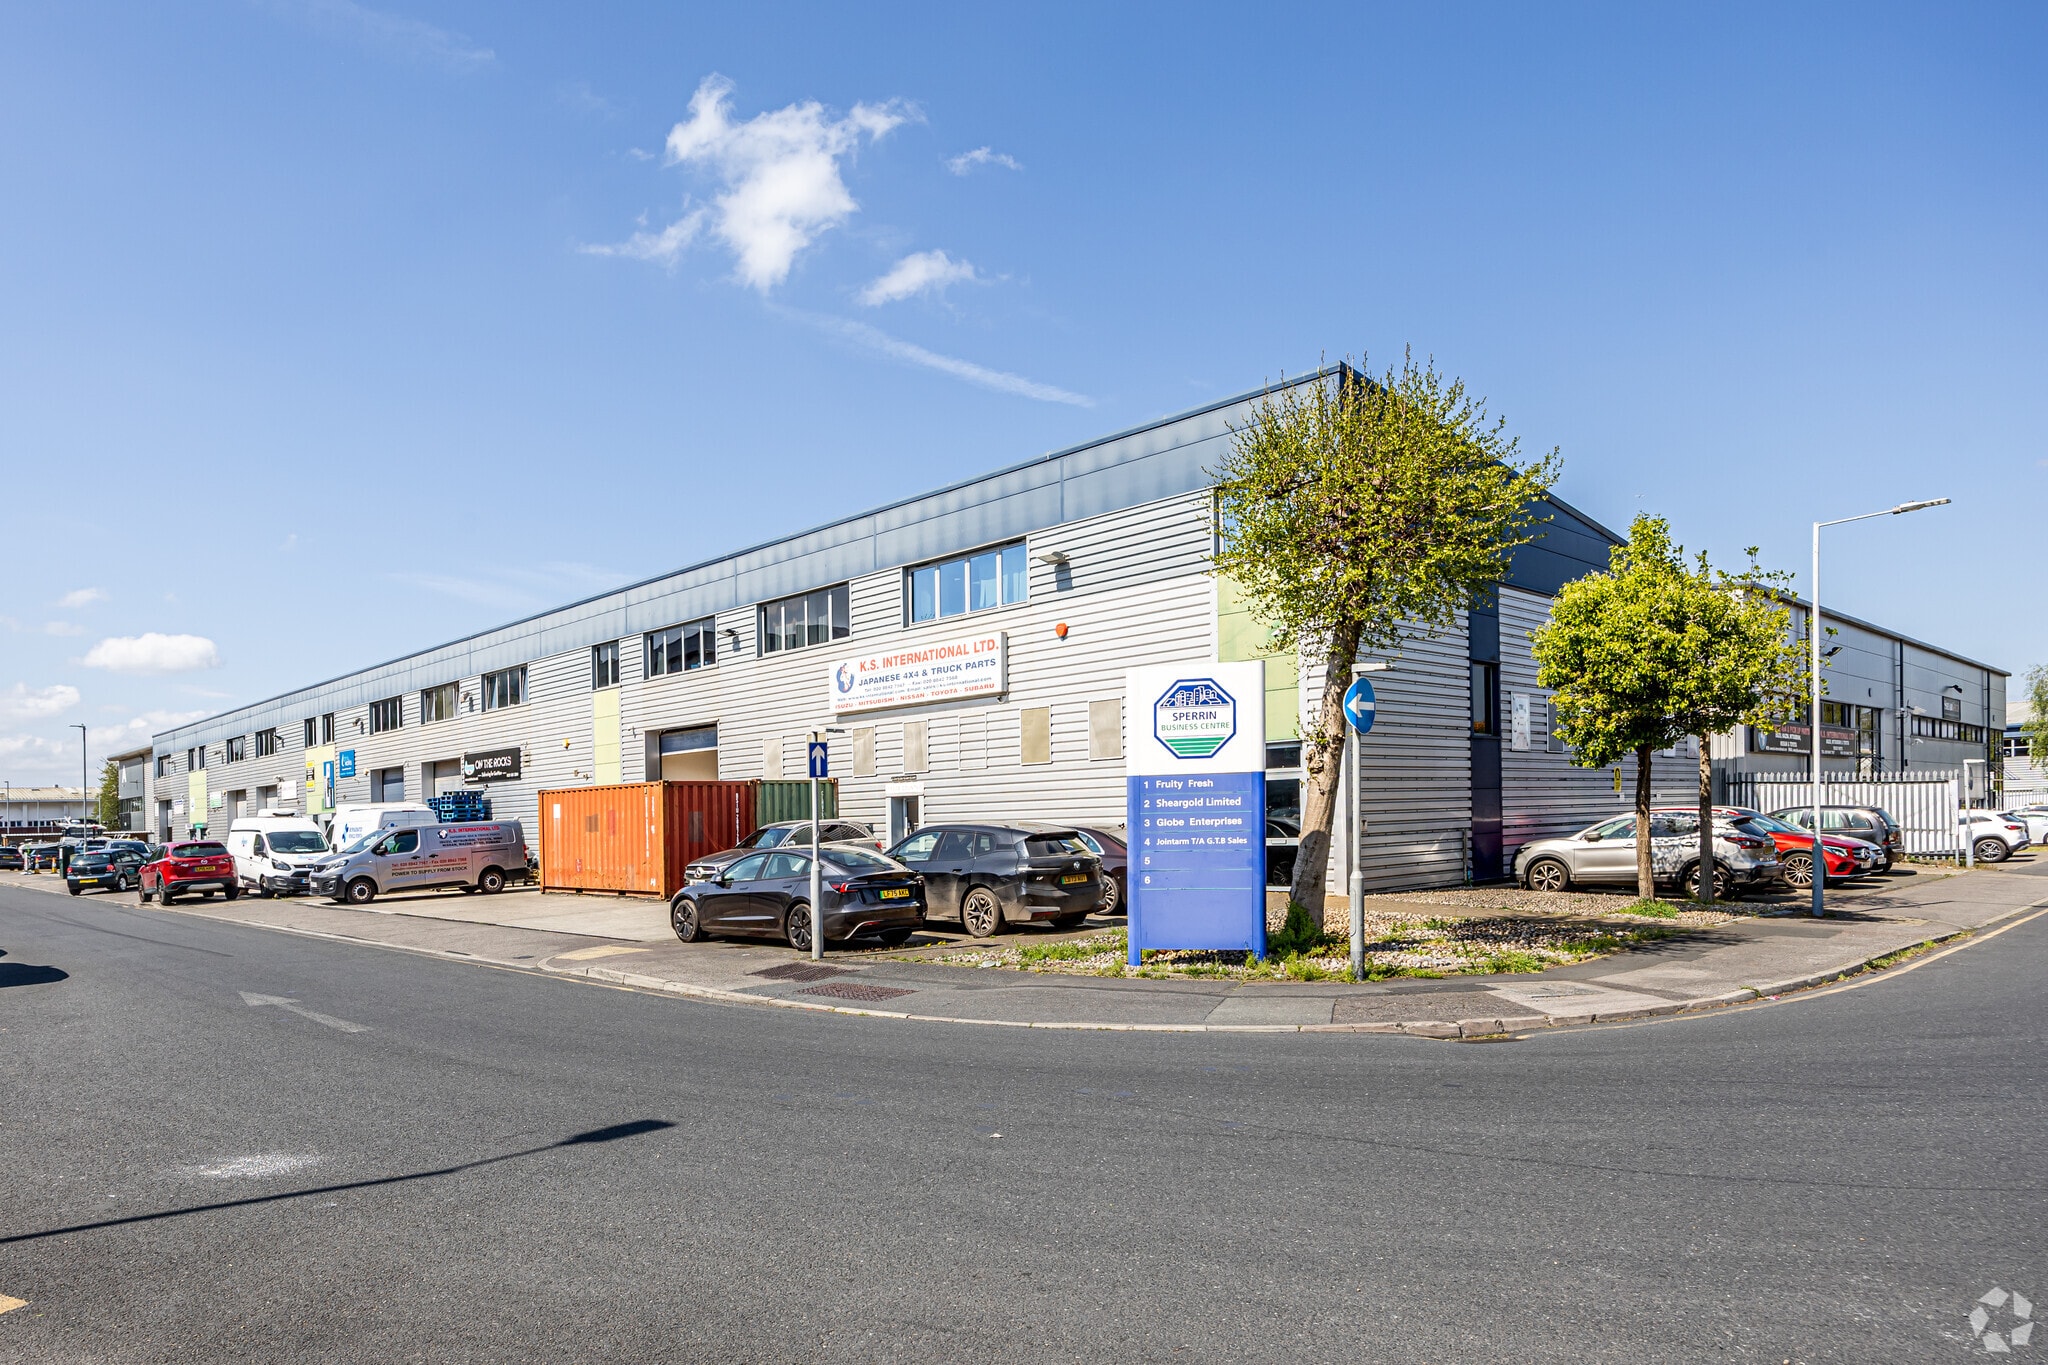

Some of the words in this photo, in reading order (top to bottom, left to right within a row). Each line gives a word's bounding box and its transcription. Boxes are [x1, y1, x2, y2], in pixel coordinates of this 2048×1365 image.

[860, 660, 879, 672] K.S.
[882, 644, 970, 668] INTERNATIONAL
[974, 639, 999, 654] LTD.
[858, 674, 900, 686] JAPANESE
[931, 664, 962, 676] TRUCK
[965, 658, 996, 670] PARTS
[858, 697, 895, 706] MITSUBISHI
[964, 684, 995, 692] SUBARU
[1172, 711, 1217, 721] SPERRIN
[1161, 724, 1198, 732] BUSINESS
[1200, 722, 1230, 730] CENTRE
[475, 760, 483, 770] ON
[484, 758, 493, 769] THE
[494, 756, 512, 768] ROCKS
[1156, 780, 1183, 790] Fruity
[1188, 779, 1214, 788] Fresh
[1144, 800, 1150, 808] 2
[1156, 798, 1203, 808] Sheargold
[1206, 797, 1242, 806] Limited
[1144, 819, 1150, 827] 3
[1156, 818, 1184, 826] Globe
[1189, 817, 1242, 827] Enterprises
[1144, 876, 1151, 884] 6
